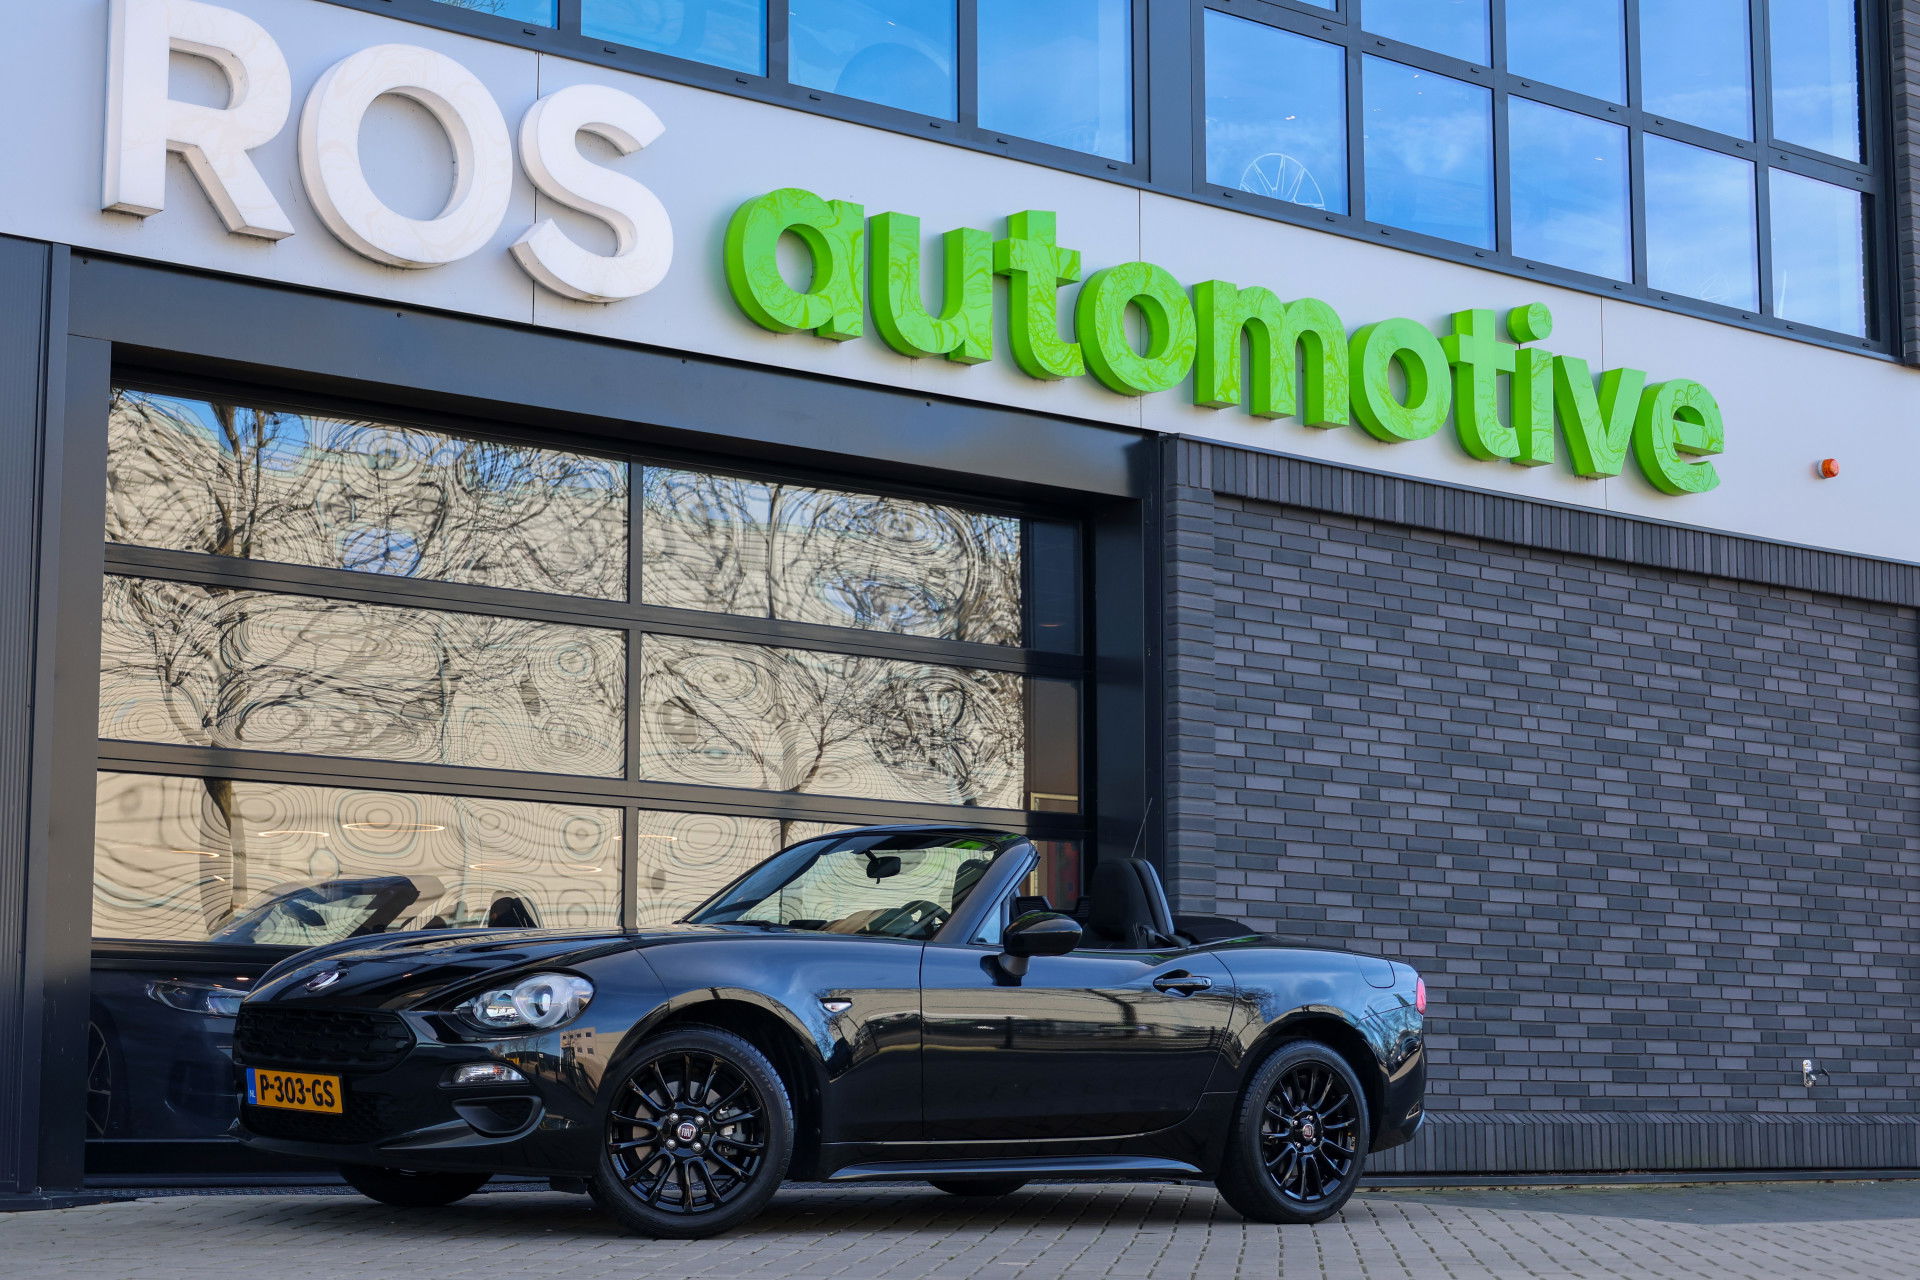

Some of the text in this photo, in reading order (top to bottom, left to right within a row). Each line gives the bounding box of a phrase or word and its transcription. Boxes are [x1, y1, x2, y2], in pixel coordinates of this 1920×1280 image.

[102, 0, 1725, 496] ROS automotive
[260, 1074, 335, 1107] P-303-GS
